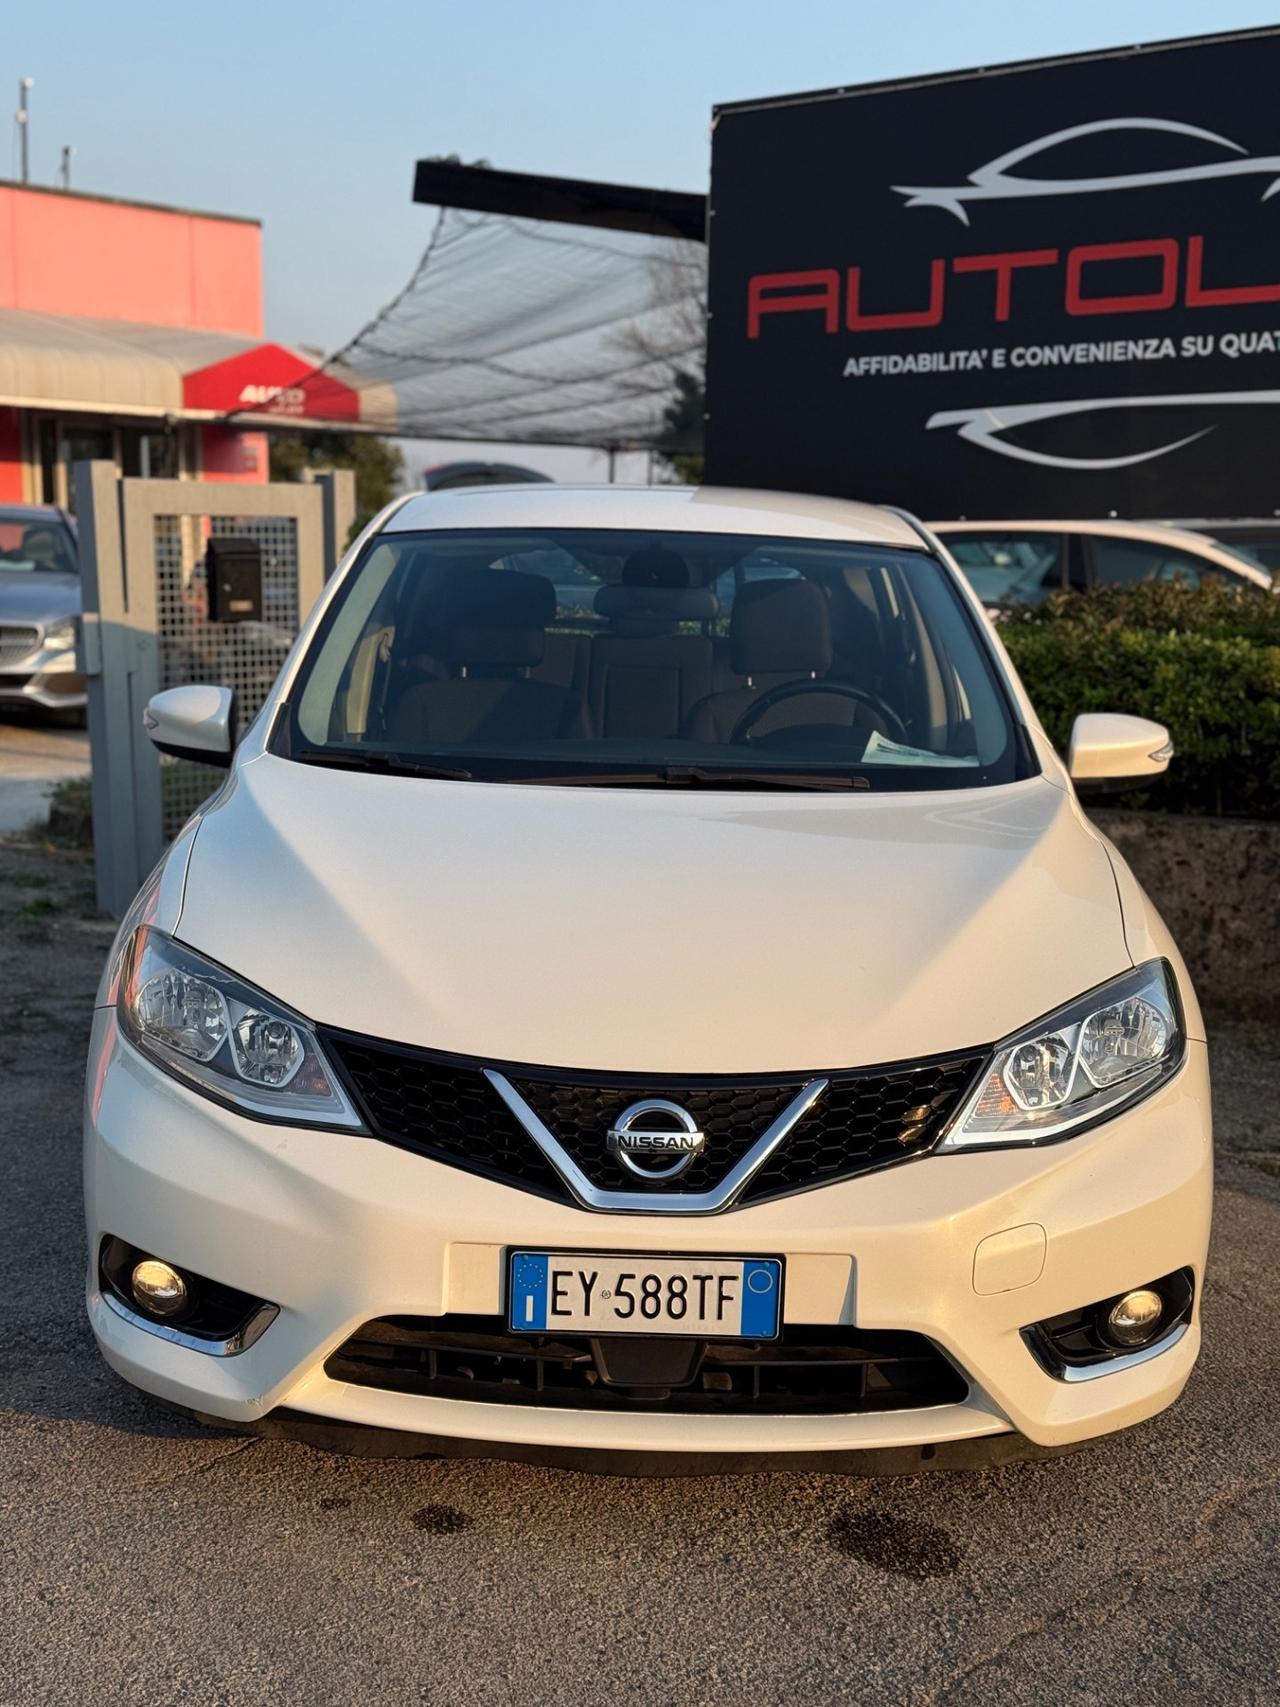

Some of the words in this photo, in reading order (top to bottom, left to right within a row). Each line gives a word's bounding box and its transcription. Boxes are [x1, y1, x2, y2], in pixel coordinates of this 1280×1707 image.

[747, 235, 1280, 338] AUTOL
[843, 348, 988, 377] AFFIDABILITA'
[991, 348, 1006, 368] E
[1010, 337, 1176, 367] CONVENIENZA
[1180, 334, 1214, 357] SU
[617, 1134, 694, 1149] NISSAN
